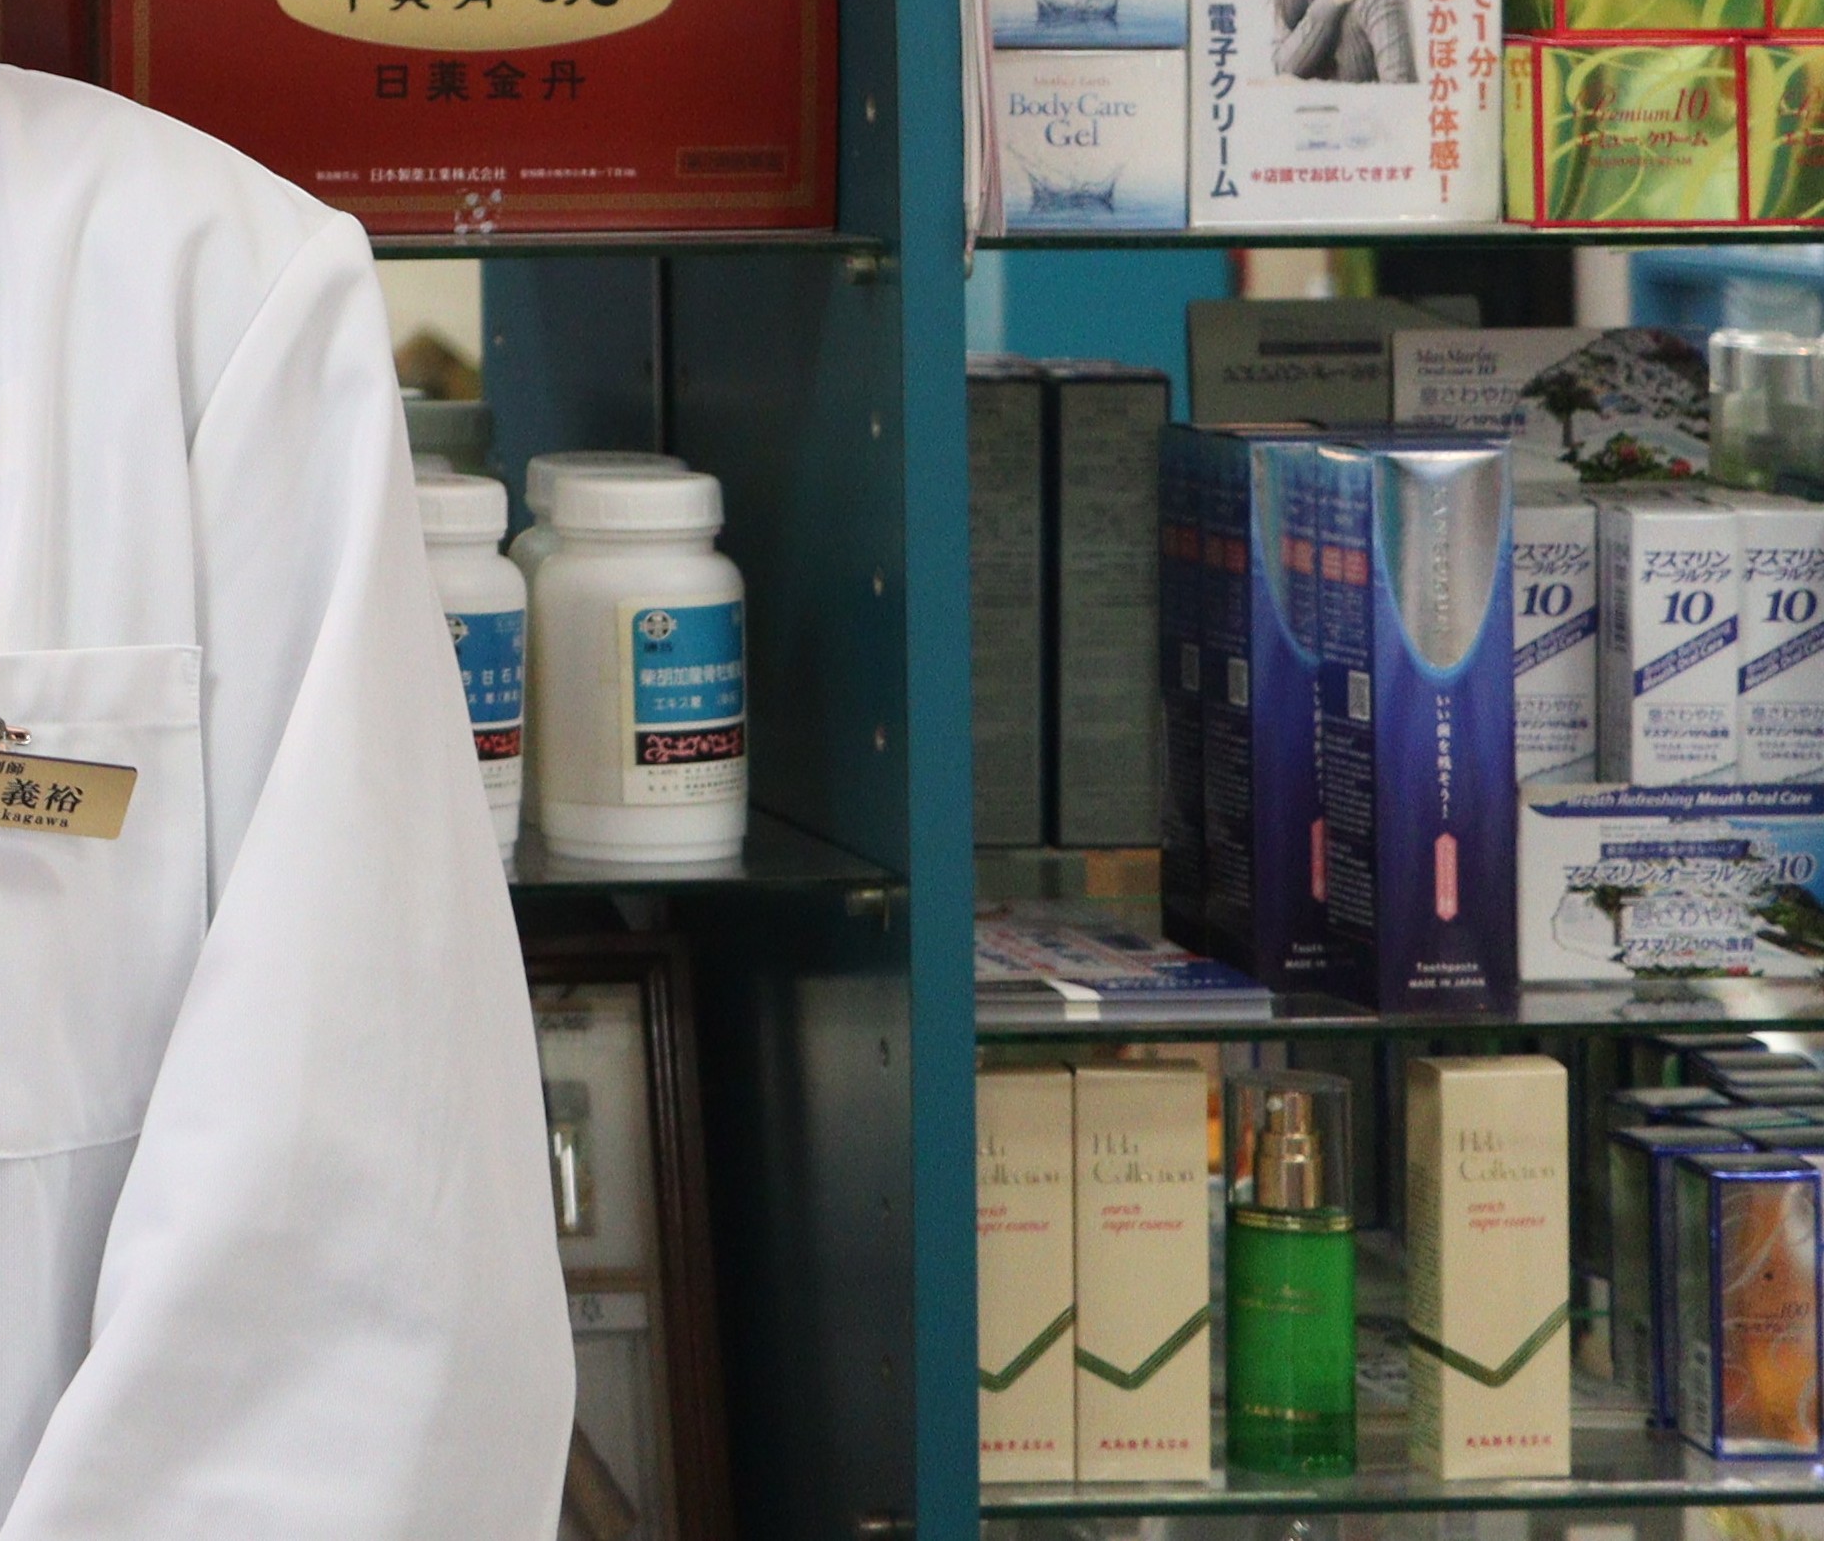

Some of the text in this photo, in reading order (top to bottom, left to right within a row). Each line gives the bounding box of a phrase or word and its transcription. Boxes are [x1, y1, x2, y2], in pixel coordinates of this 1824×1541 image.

[1008, 93, 1137, 120] Body Care
[1207, 3, 1240, 200] 電子クリーム
[1044, 118, 1101, 147] Gel
[1643, 549, 1731, 567] マスマリン
[1519, 582, 1573, 617] 10
[1659, 590, 1715, 625] 10
[1762, 588, 1818, 623] 10
[1, 777, 85, 814] 義裕
[1696, 792, 1743, 805] Mouth
[1746, 792, 1778, 805] Oral
[1779, 792, 1813, 805] Care
